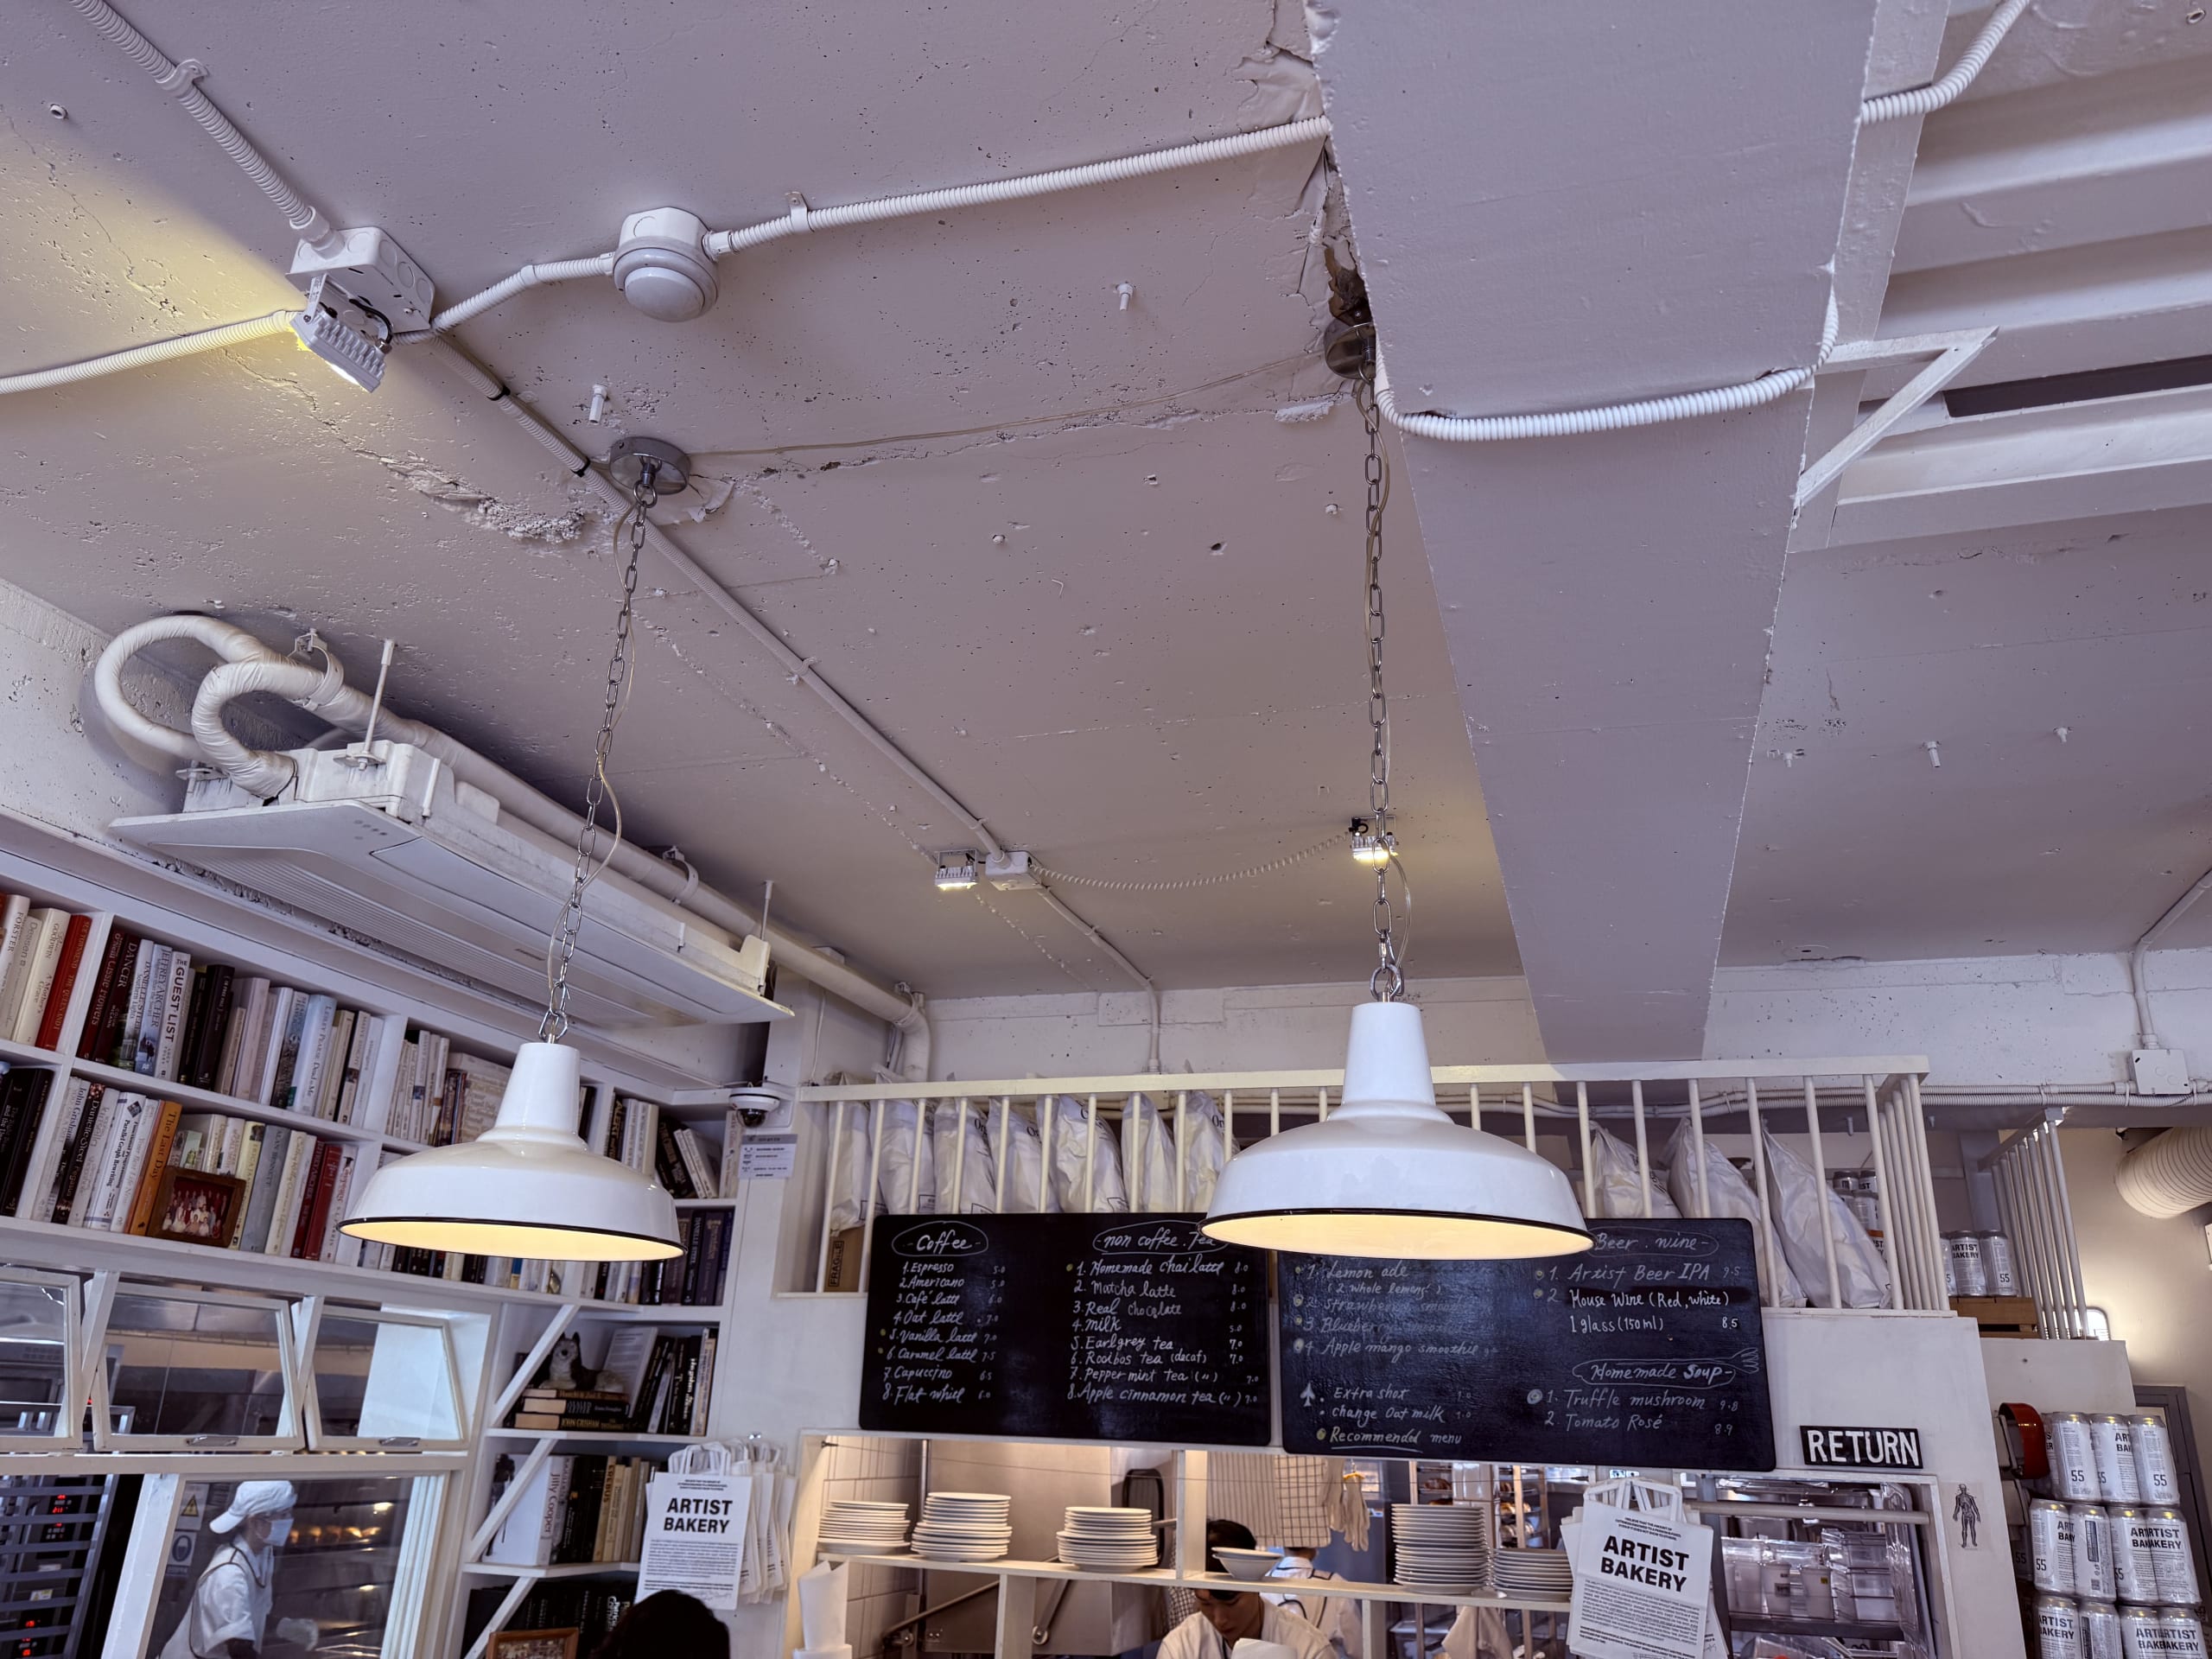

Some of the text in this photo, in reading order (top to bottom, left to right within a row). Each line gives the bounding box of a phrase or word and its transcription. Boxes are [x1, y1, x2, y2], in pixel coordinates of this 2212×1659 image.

[118, 942, 137, 988] DANCER
[165, 969, 185, 1042] GUEST LIST
[67, 1087, 86, 1140] John Grisham
[152, 1112, 176, 1180] The Last Day
[917, 1230, 972, 1255] Coffee
[1138, 1227, 1179, 1250] coffee
[1594, 1233, 1638, 1251] Beer
[830, 1242, 842, 1285] FRAGILE
[1090, 1258, 1154, 1276] Homemade
[1567, 1263, 1626, 1288] Artist
[1634, 1265, 1675, 1281] Beer
[1678, 1263, 1710, 1281] IPA
[1999, 1274, 2010, 1283] 55
[1091, 1280, 1135, 1296] Matcha
[1139, 1281, 1176, 1298] latte
[1570, 1289, 1606, 1308] House
[1085, 1297, 1122, 1316] Real
[1722, 1317, 1738, 1330] 8.5
[1321, 1338, 1362, 1357] Apple
[1085, 1351, 1132, 1365] Rooibos
[1590, 1363, 1723, 1385] Homemade Soup
[1077, 1382, 1114, 1404] Apple
[1120, 1389, 1186, 1403] cinnamon
[1333, 1387, 1373, 1400] Extra
[1377, 1383, 1409, 1401] shot
[1563, 1389, 1620, 1409] Truffle
[1630, 1389, 1705, 1410] mushroom
[1385, 1407, 1409, 1421] Oat
[1412, 1404, 1446, 1423] milk
[1566, 1414, 1620, 1432] Tomato
[1627, 1414, 1663, 1432] Rosé
[1330, 1426, 1462, 1444] Recommended menu
[1807, 1430, 1919, 1466] RETURN
[2071, 1470, 2085, 1482] 55
[2153, 1474, 2168, 1486] 55
[544, 1473, 560, 1533] Jilly Cooper
[667, 1497, 733, 1516] ARTIST
[664, 1517, 729, 1534] BAKERY
[1604, 1535, 1689, 1571] ARTIST
[2150, 1540, 2182, 1550] AKERY
[1600, 1556, 1687, 1592] BAKERY
[2036, 1558, 2047, 1571] 55
[2165, 1642, 2199, 1651] AKERY
